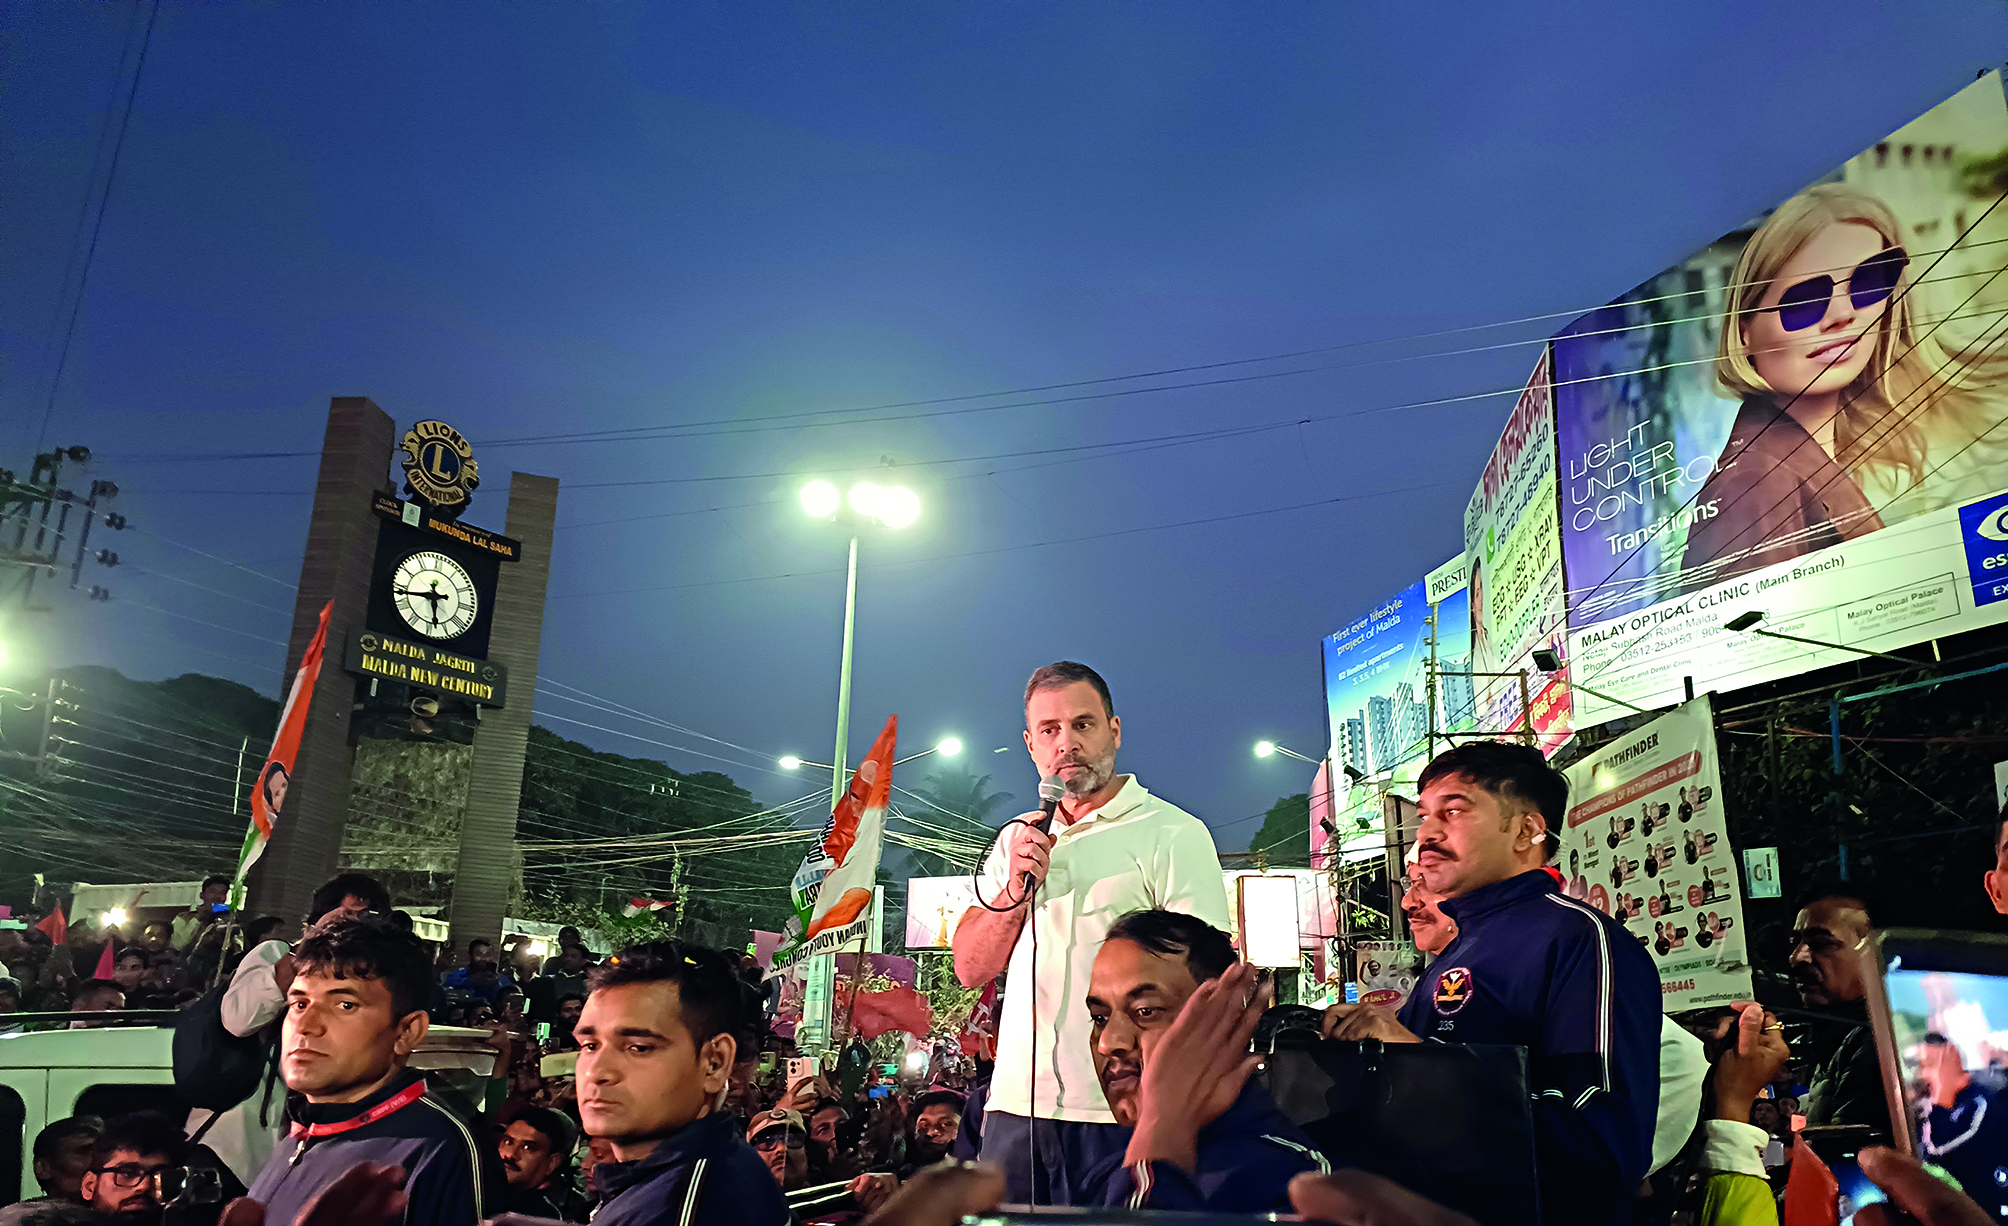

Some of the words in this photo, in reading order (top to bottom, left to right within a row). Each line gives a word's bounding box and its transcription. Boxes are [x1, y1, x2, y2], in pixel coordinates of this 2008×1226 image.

[423, 422, 467, 452] LIONS
[1570, 419, 1650, 480] LIGHT
[431, 443, 451, 481] L
[1571, 440, 1675, 505] UNDER
[410, 470, 464, 503] INTERNATIONAL
[428, 518, 471, 543] MUKUNDA
[472, 535, 489, 550] LAL
[489, 541, 513, 557] SAHA
[1534, 508, 1554, 554] XRAY
[1605, 499, 1720, 556] Transitions
[1514, 573, 1529, 607] EEG
[1536, 539, 1551, 573] VPT
[1581, 622, 1627, 648] MALAY
[1630, 603, 1695, 631] OPTICAL
[1698, 582, 1750, 610] CLINIC
[1755, 573, 1790, 594] (Main
[1792, 554, 1846, 580] Branch)
[1847, 607, 1873, 620] Malay
[1875, 596, 1909, 613] Optical
[1911, 586, 1944, 601] Palace
[1332, 628, 1351, 644] First
[1350, 619, 1369, 634] ever
[1369, 598, 1403, 625] lifestyle
[1337, 633, 1365, 657] project
[1365, 626, 1376, 640] of
[1375, 614, 1401, 635] Malda
[1655, 622, 1683, 638] Road
[1685, 612, 1718, 629] Malda
[382, 638, 426, 661] MALDA
[432, 652, 475, 674] JAGRITI
[362, 653, 407, 679] MALDA
[410, 666, 440, 687] NEW
[441, 675, 495, 700] CENTURY
[1606, 676, 1620, 687] Eye
[1620, 674, 1636, 683] Care
[1636, 668, 1649, 679] and
[1602, 731, 1660, 770] PATHFINDER
[1617, 790, 1627, 801] OF
[1626, 769, 1668, 798] PATHFINDER
[1437, 1019, 1455, 1032] 235
